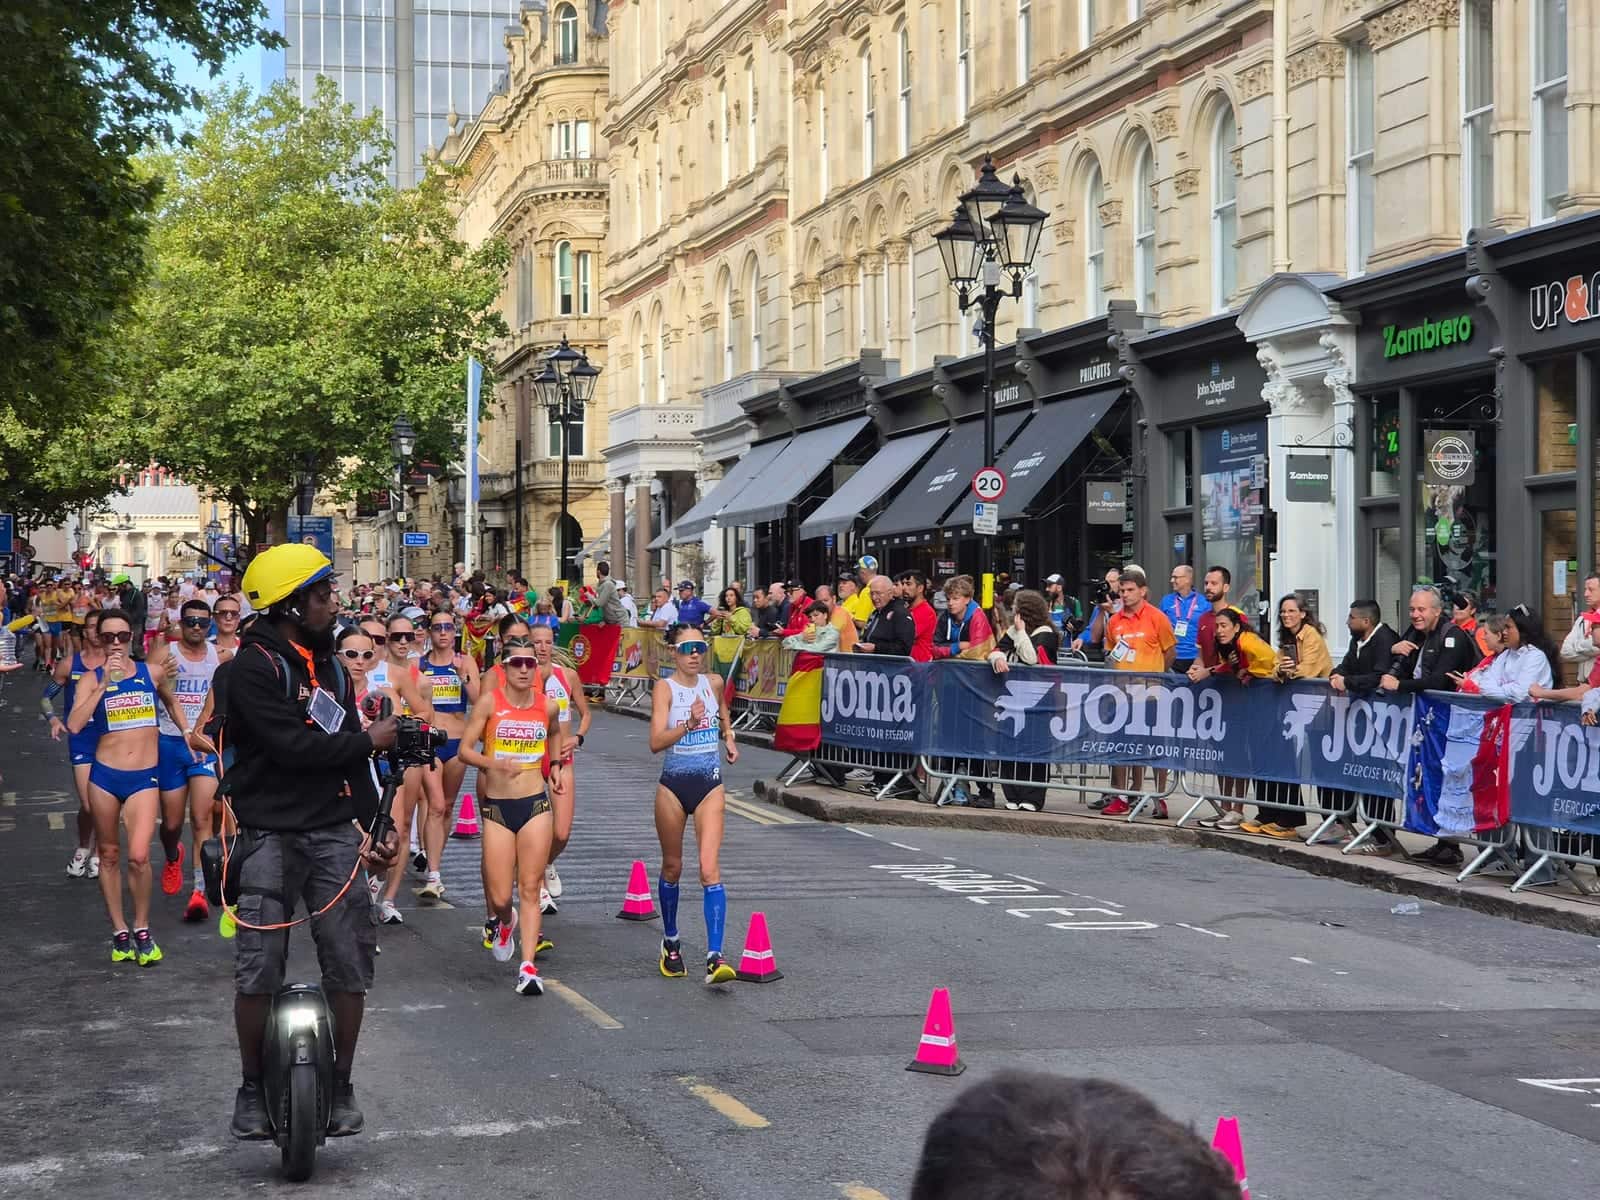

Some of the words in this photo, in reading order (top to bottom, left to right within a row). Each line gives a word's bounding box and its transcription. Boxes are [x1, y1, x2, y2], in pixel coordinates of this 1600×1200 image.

[1383, 314, 1471, 358] Zambrero
[1080, 362, 1111, 384] PHILPOTTS
[1197, 382, 1210, 399] John
[1210, 376, 1235, 395] Shepherd
[1289, 471, 1329, 480] Zambrero
[979, 477, 1001, 491] 20
[1101, 500, 1126, 508] Shepherd
[429, 677, 449, 686] PAR
[107, 697, 142, 708] SPAR
[107, 705, 154, 718] OLYANOVSKA
[498, 727, 535, 739] SPAR
[834, 722, 866, 737] EXERCISE
[1321, 695, 1414, 763] Jom
[502, 739, 512, 747] M
[514, 739, 538, 749] PEREZ
[678, 729, 718, 746] ALMISAN
[1081, 741, 1143, 756] EXERCISE
[1147, 744, 1180, 759] YOUR
[1183, 747, 1224, 762] FREEDOM
[1342, 763, 1381, 781] EXERCISE
[1553, 797, 1597, 817] EXERCISE
